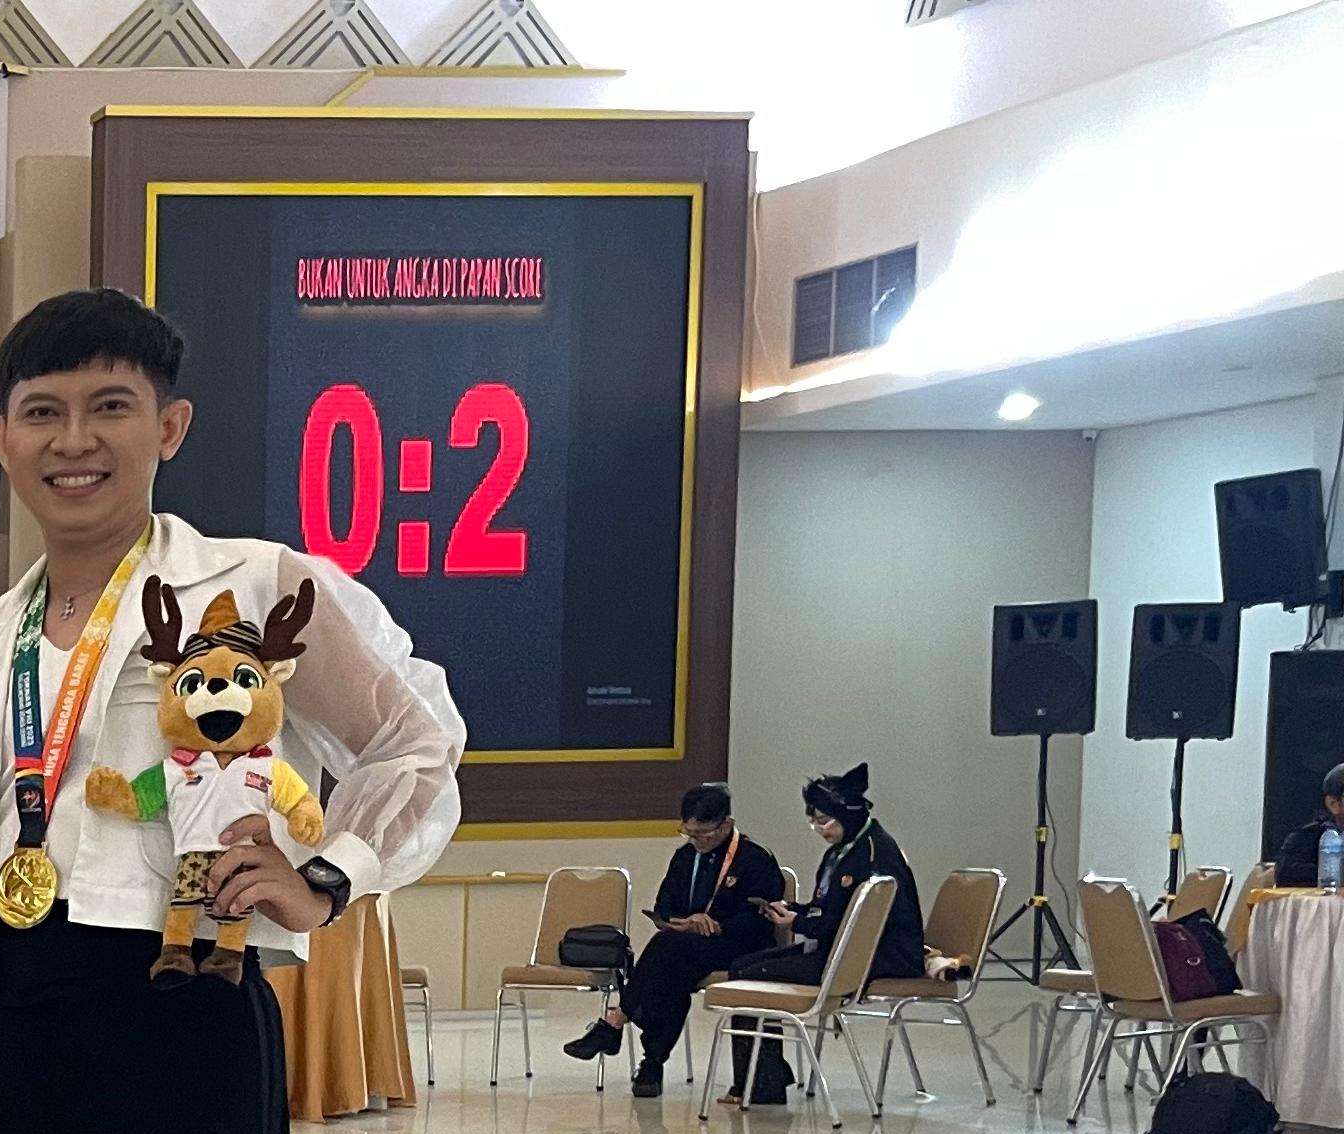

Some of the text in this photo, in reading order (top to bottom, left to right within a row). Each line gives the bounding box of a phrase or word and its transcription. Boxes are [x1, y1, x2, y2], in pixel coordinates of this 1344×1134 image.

[297, 256, 543, 299] BUKAN UNTUK ANGKA DI PAPAN SCORE
[297, 382, 531, 577] 0:2
[43, 746, 61, 777] NUSA
